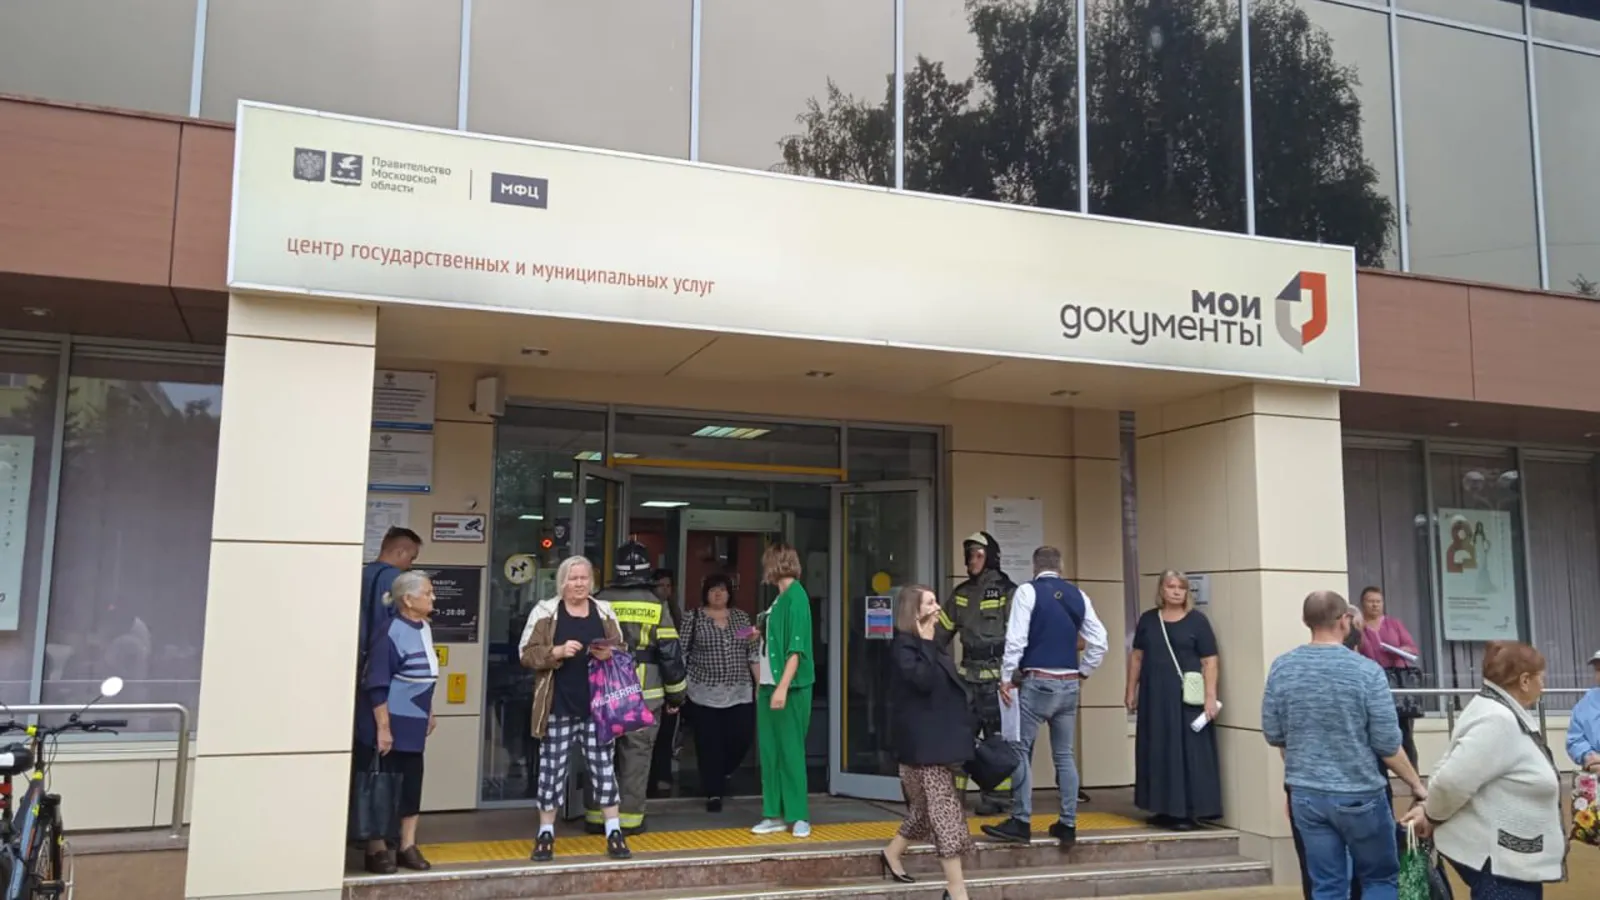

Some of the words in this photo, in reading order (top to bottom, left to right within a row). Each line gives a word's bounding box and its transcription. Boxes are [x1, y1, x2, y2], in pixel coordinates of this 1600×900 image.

[371, 156, 451, 176] Правительство
[371, 168, 437, 185] Московской
[370, 180, 414, 194] области
[500, 182, 539, 200] МФЦ
[287, 237, 344, 260] центр
[351, 243, 510, 273] государственных
[515, 261, 526, 275] и
[532, 263, 669, 289] муниципальных
[672, 276, 716, 298] услуг
[1059, 303, 1263, 347] документы
